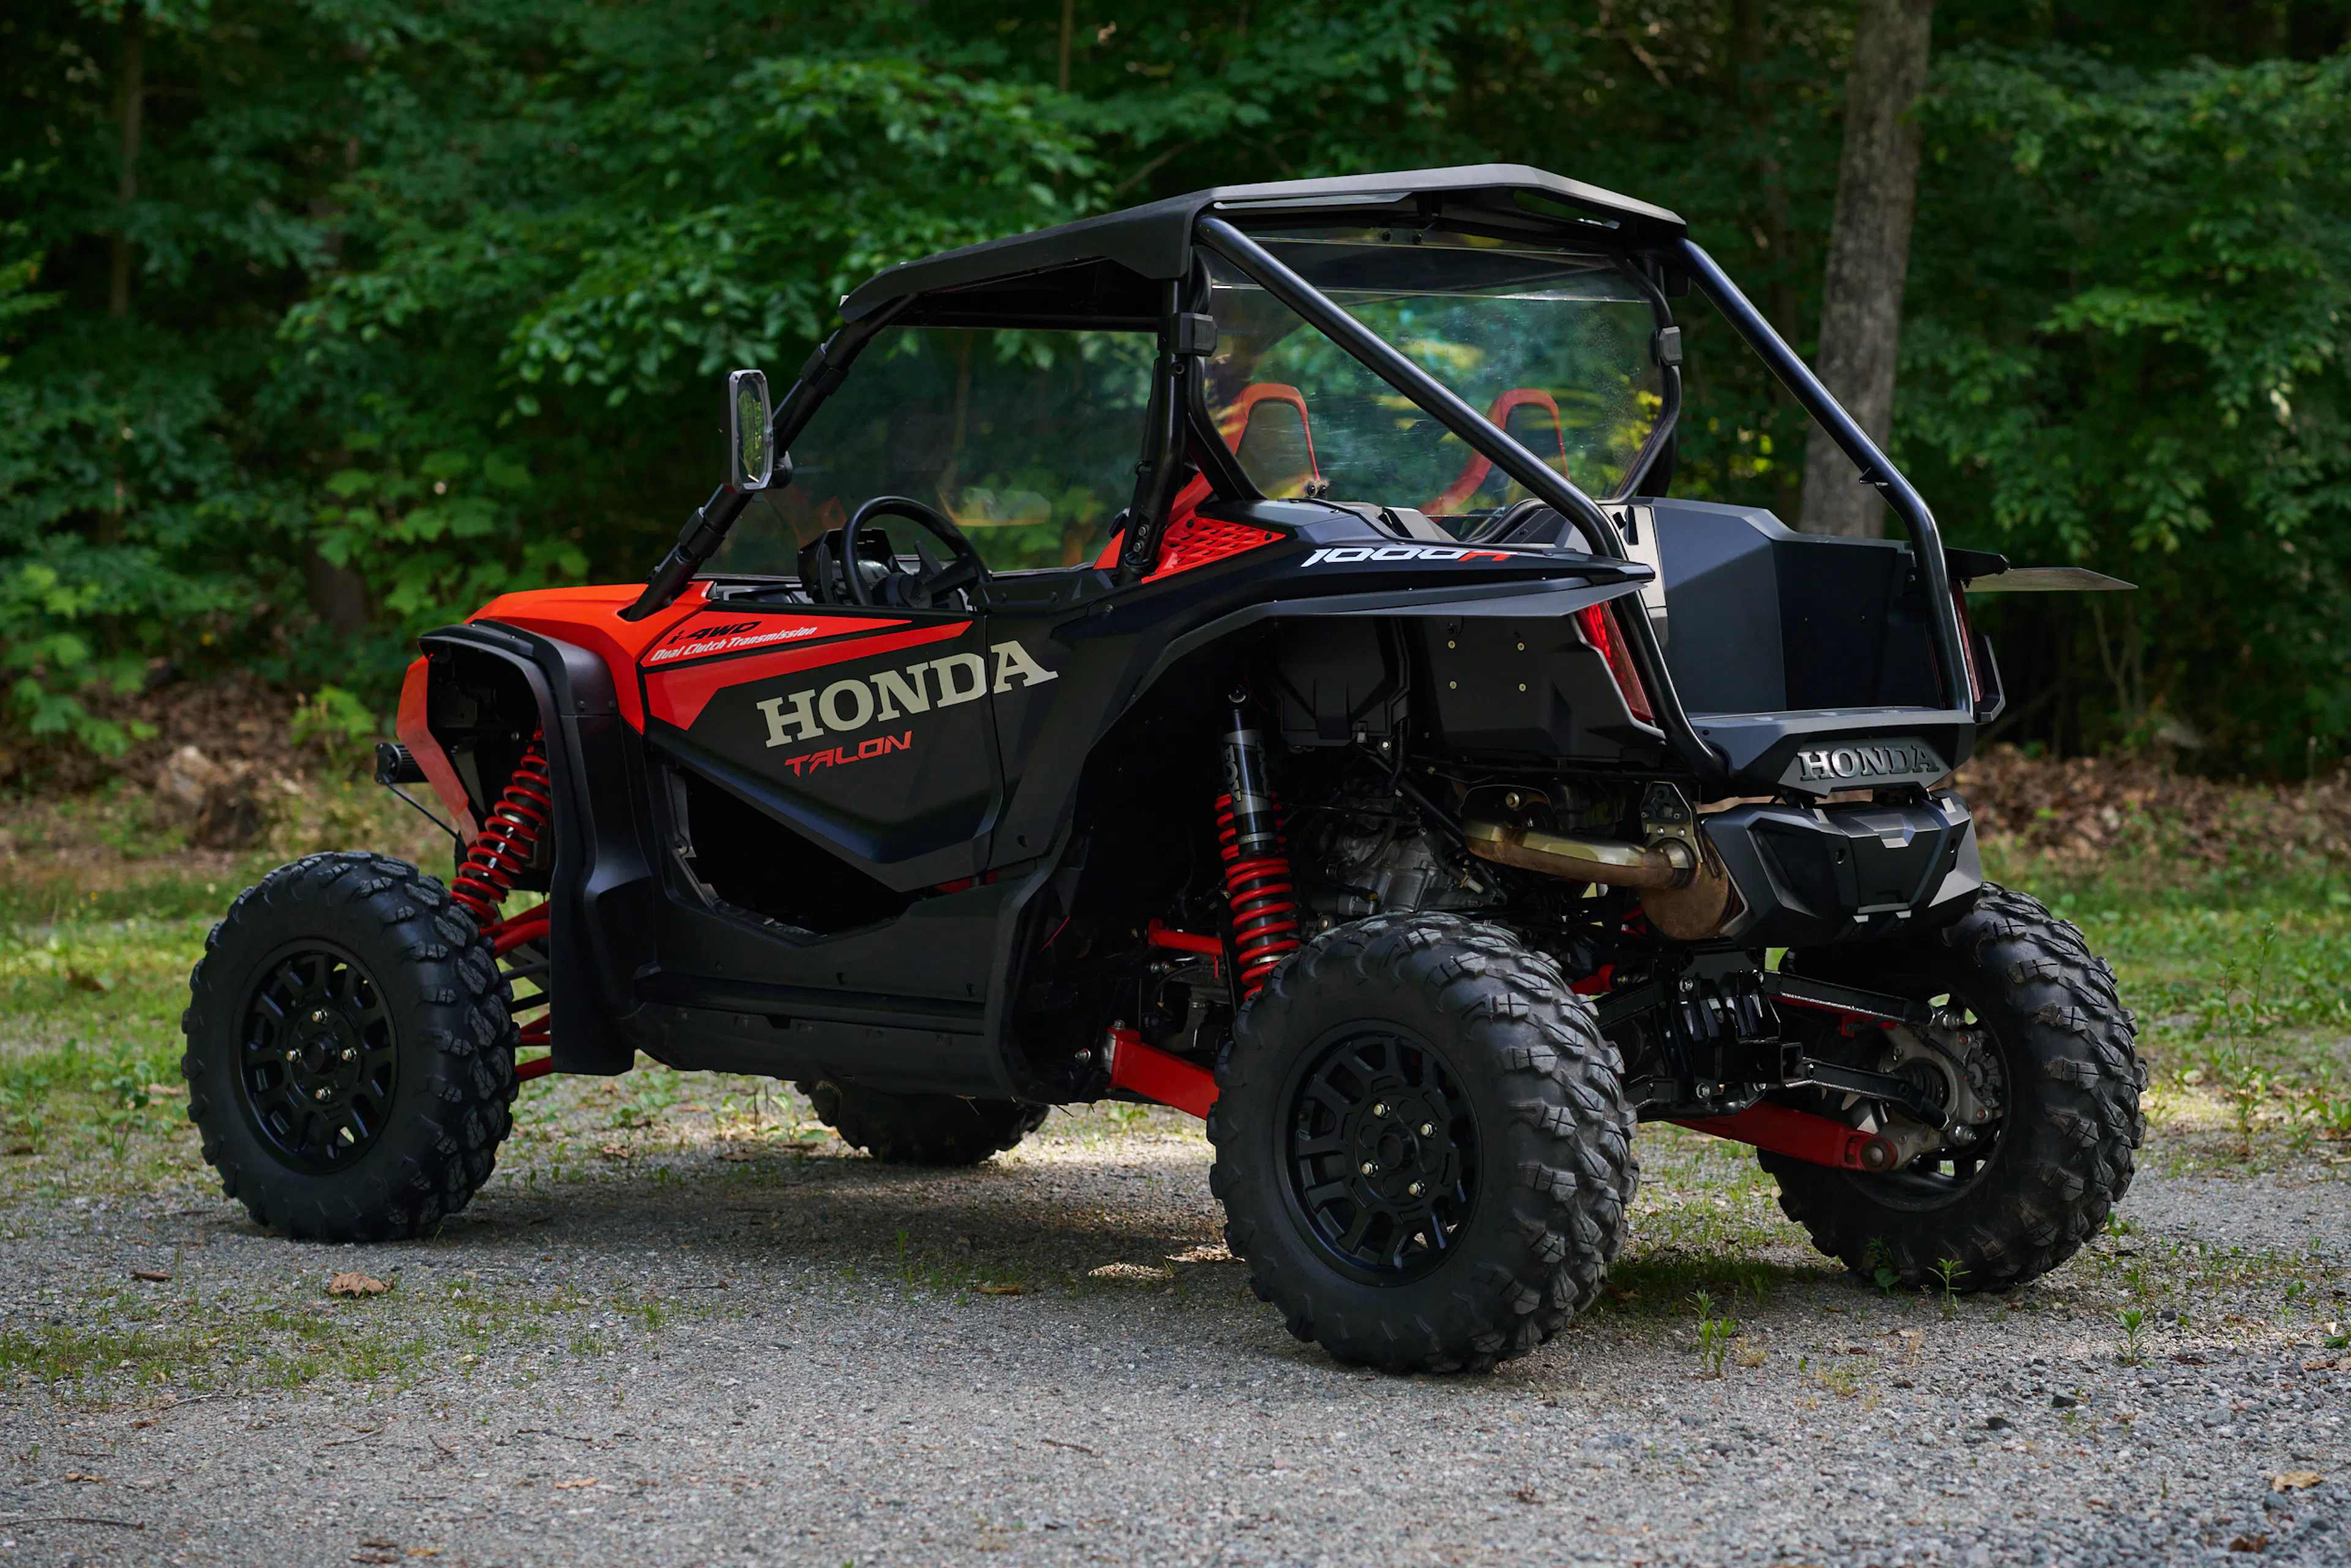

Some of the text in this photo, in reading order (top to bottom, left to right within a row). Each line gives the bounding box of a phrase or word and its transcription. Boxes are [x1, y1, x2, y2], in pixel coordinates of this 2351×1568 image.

[650, 627, 818, 661] Dual Clutch Transmission
[757, 640, 1058, 747] HONDA
[785, 730, 912, 776] TALON
[1797, 745, 1940, 781] HONDA
